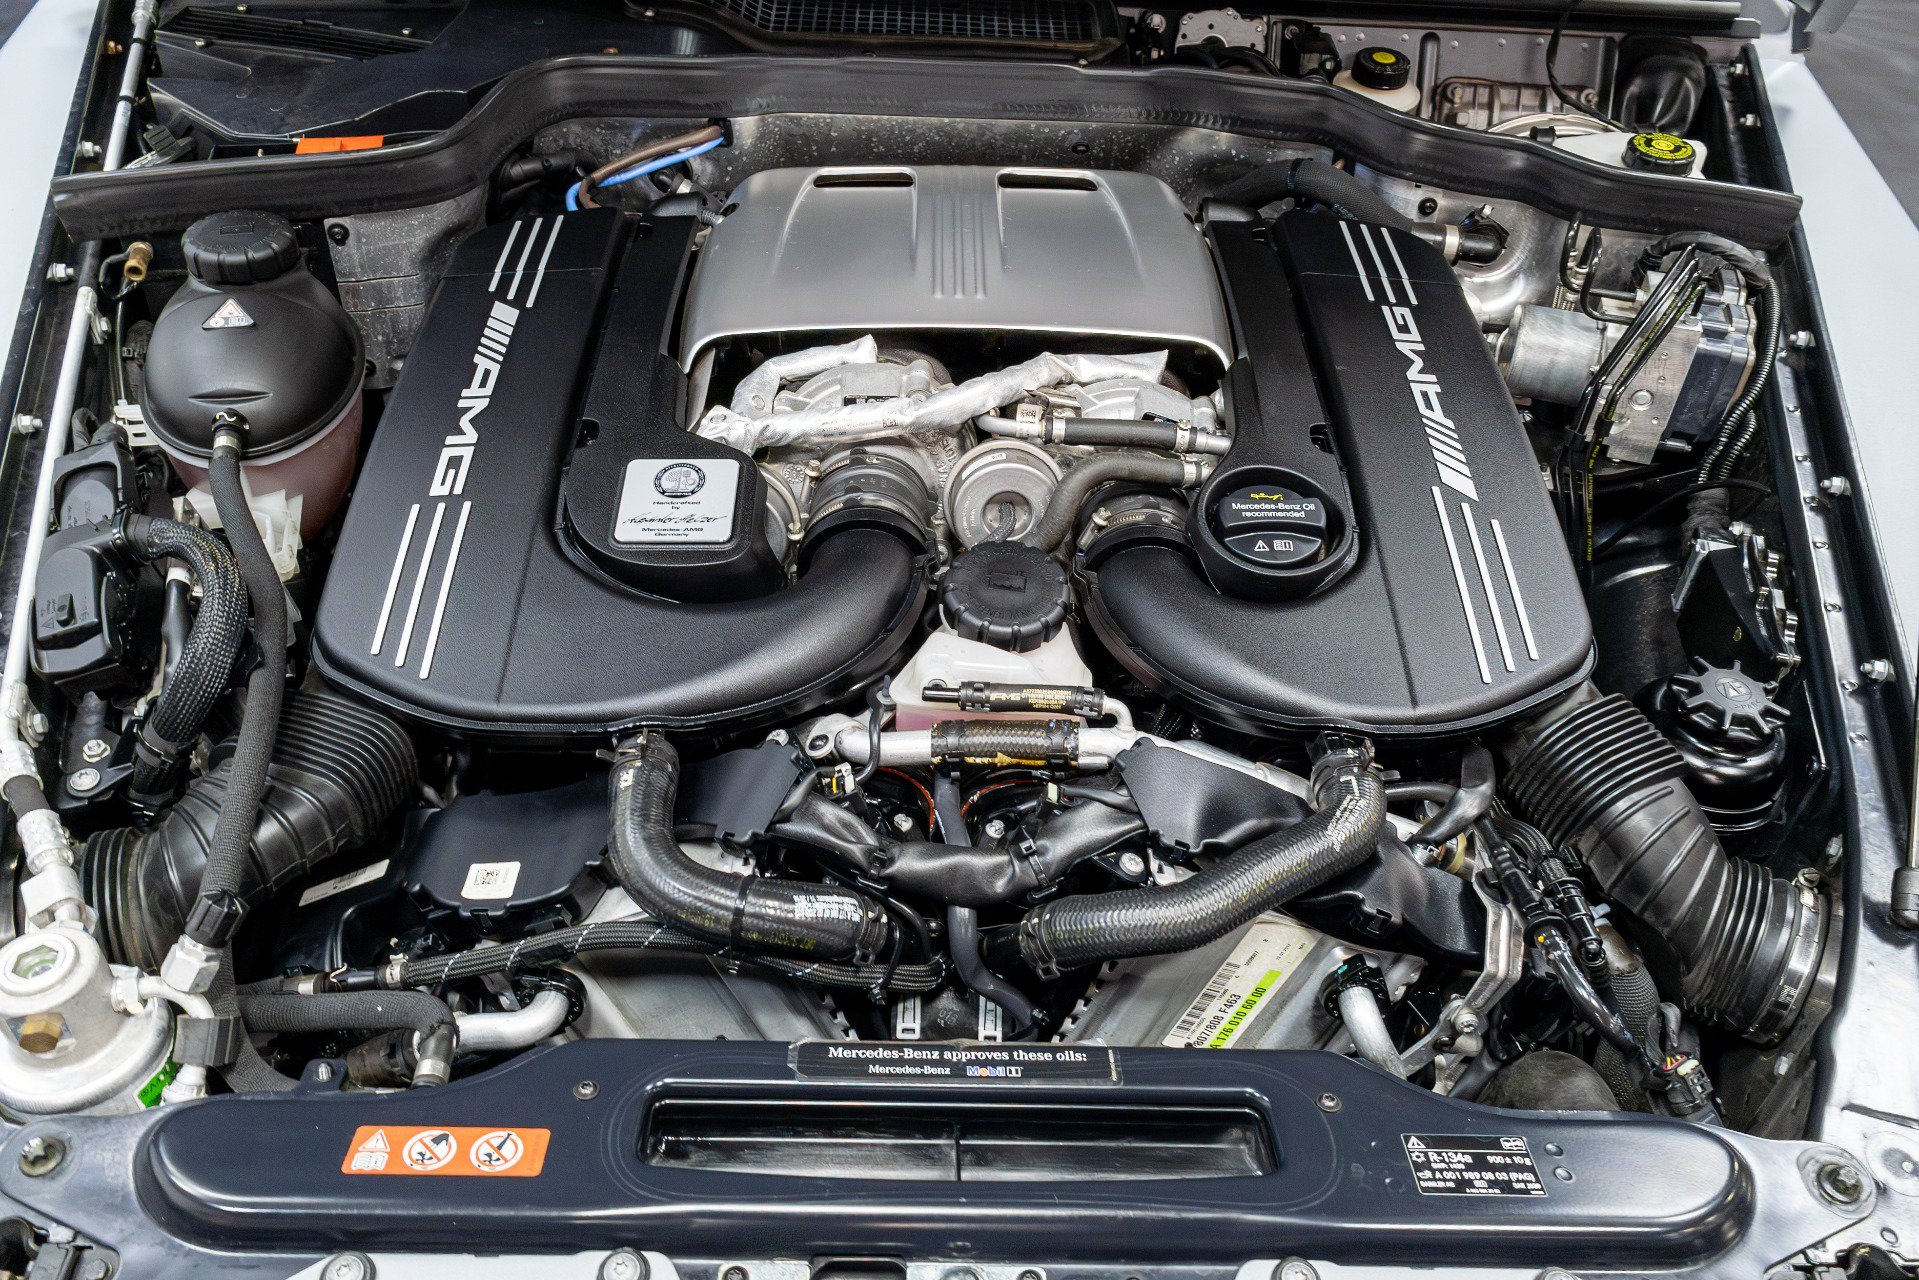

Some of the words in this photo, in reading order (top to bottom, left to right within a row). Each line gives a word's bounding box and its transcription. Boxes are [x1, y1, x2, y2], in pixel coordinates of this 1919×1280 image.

[429, 353, 501, 496] AMG
[1303, 503, 1316, 511] Oil
[1193, 1015, 1224, 1047] 807/808
[1218, 993, 1241, 1014] F463
[1216, 1027, 1234, 1041] 176
[1228, 1011, 1247, 1026] 010
[1241, 999, 1256, 1010] 60
[1251, 987, 1267, 998] 00
[828, 1046, 940, 1059] Mercedes-Benz
[943, 1050, 1010, 1062] approves
[1013, 1050, 1053, 1061] these
[1056, 1050, 1087, 1061] oils:
[868, 1064, 951, 1075] Mercedes-Benz
[966, 1065, 1006, 1077] Mobil
[1427, 1151, 1473, 1163] R-134a
[1486, 1155, 1505, 1164] 900
[1512, 1156, 1524, 1164] 10
[1435, 1170, 1443, 1179] A
[1442, 1170, 1462, 1180] 001
[1508, 1171, 1536, 1183] (PAG)
